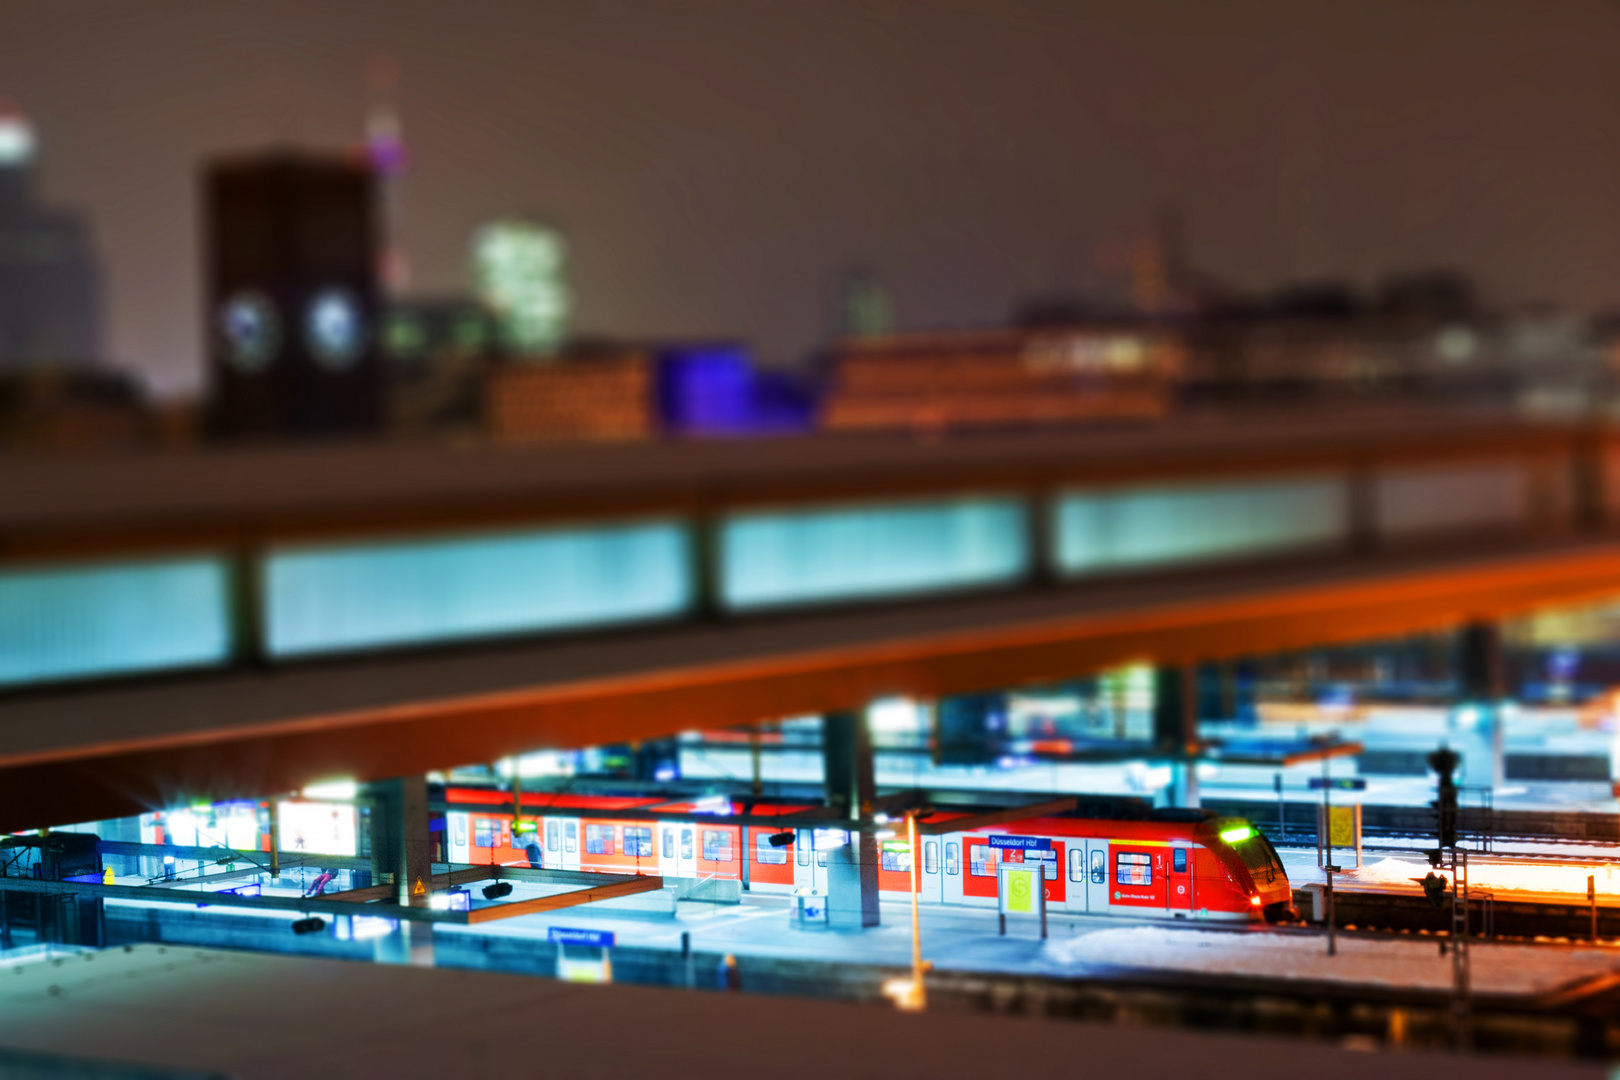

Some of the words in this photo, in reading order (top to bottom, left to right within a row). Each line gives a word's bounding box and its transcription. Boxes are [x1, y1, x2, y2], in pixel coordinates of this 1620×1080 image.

[991, 837, 1024, 846] Düsseldorf
[1026, 839, 1037, 847] Hbf
[1156, 854, 1162, 865] 1
